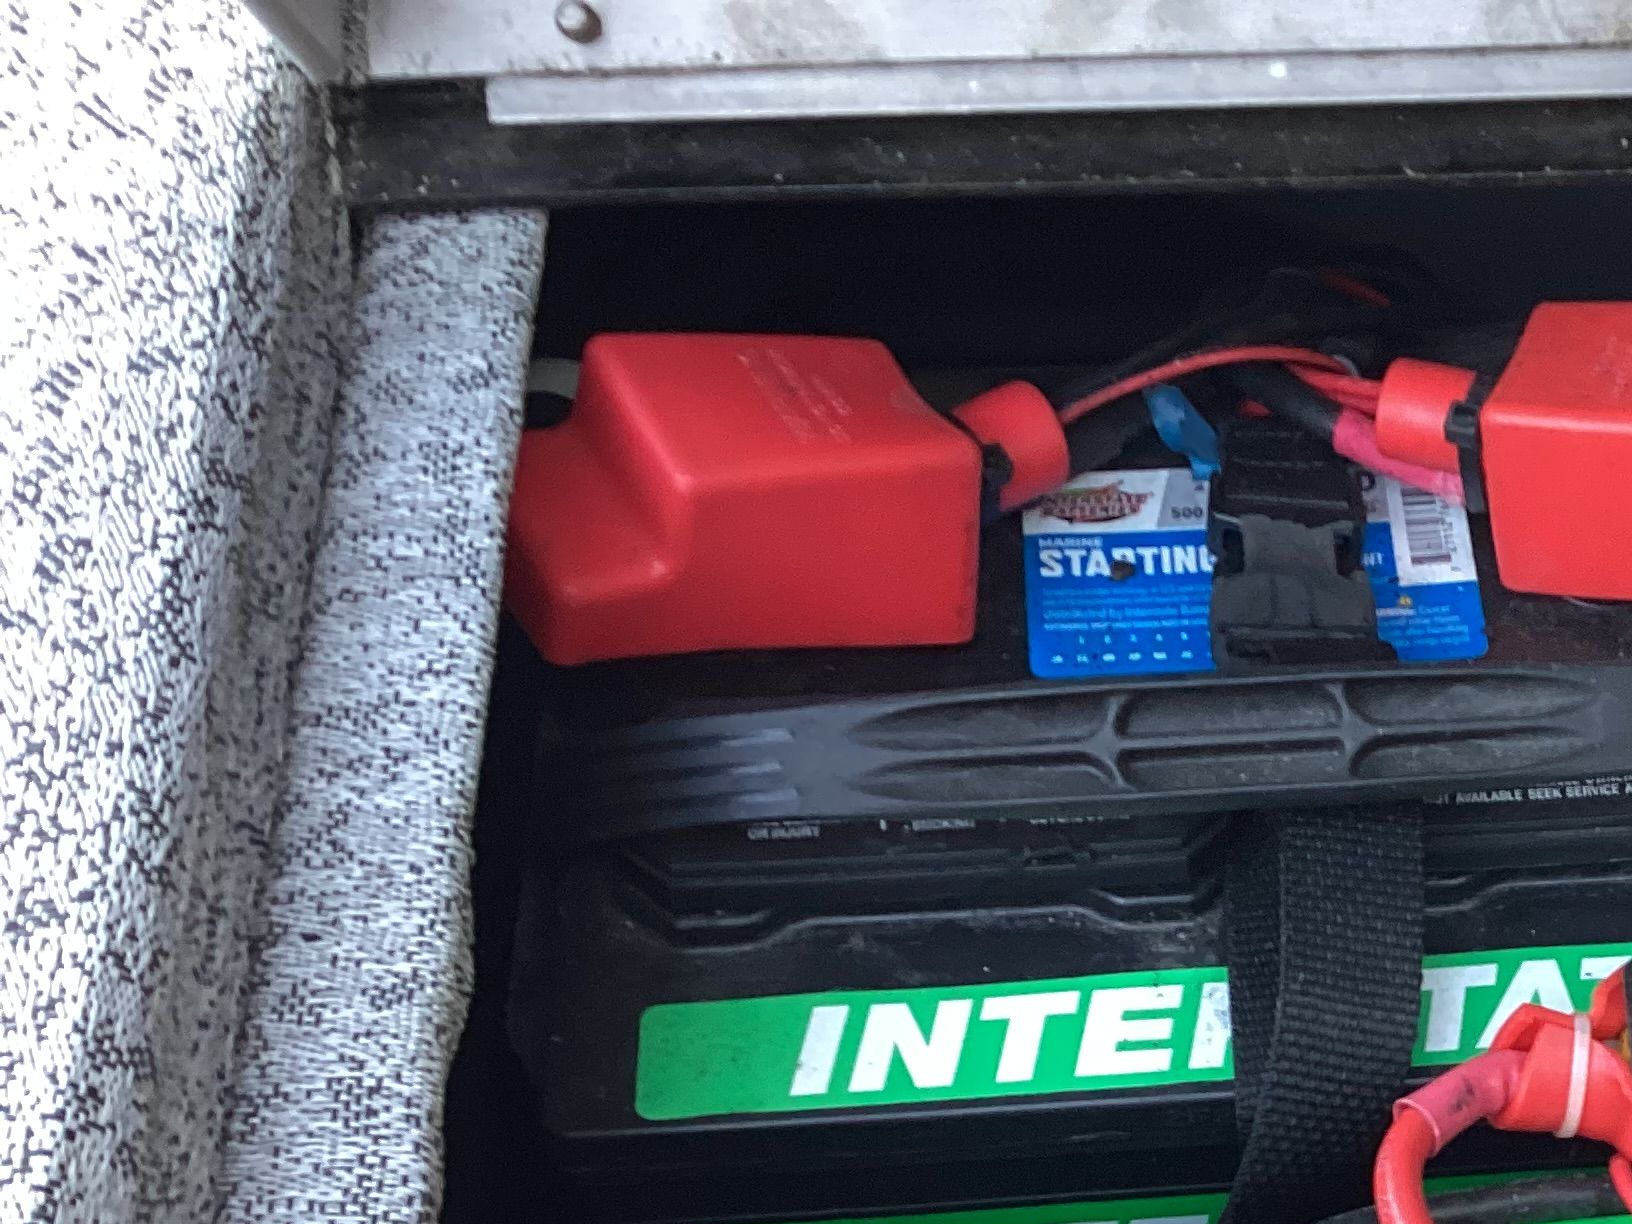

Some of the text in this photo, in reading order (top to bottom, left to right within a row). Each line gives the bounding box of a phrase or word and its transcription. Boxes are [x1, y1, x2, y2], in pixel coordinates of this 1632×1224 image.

[1455, 788, 1522, 804] AVAILABLE
[1527, 787, 1561, 801] SEEK
[1565, 783, 1620, 799] SERVICE
